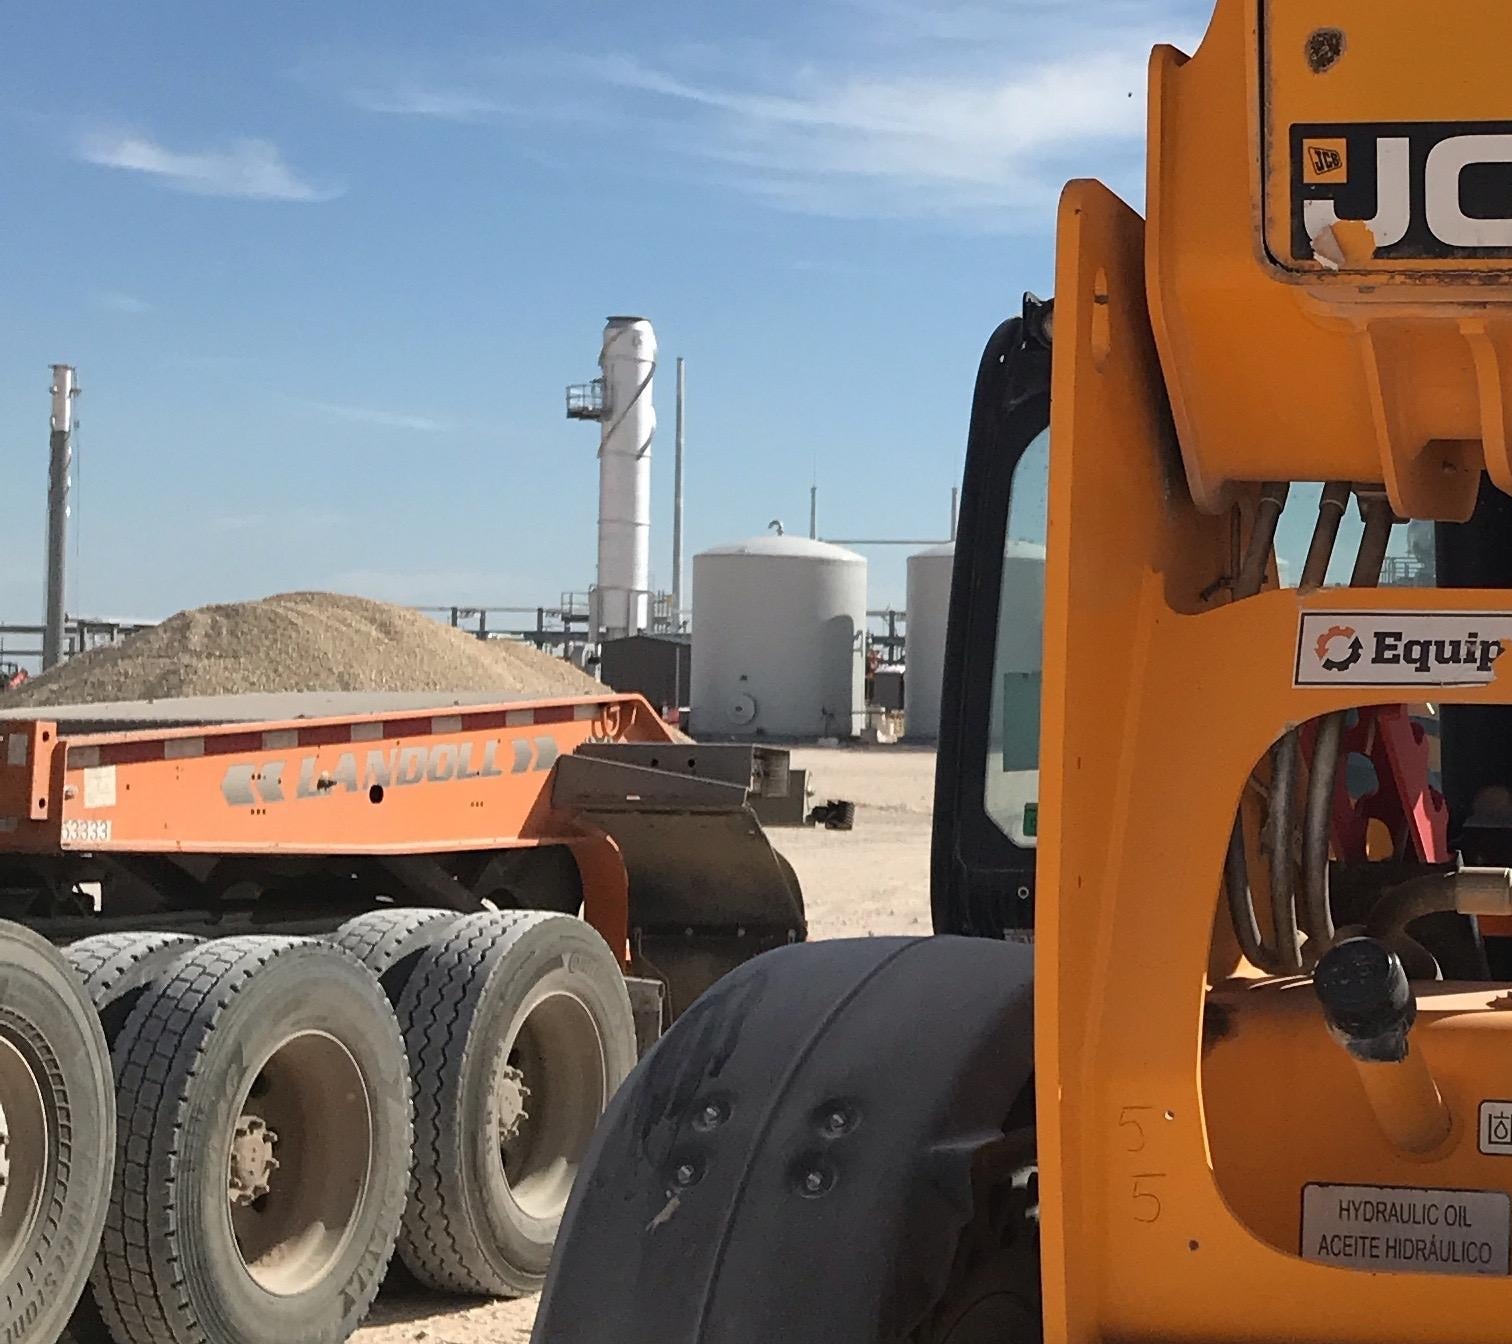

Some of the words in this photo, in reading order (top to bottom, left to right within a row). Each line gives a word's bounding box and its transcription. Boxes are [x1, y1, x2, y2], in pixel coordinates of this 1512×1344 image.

[1313, 148, 1341, 172] JCB
[296, 738, 503, 800] LANDOLL
[1338, 1199, 1439, 1226] HYDRAULIC
[1444, 1204, 1472, 1228] OIL
[1317, 1233, 1381, 1259] ACEITE
[1385, 1233, 1492, 1265] HIDRÁULICO
